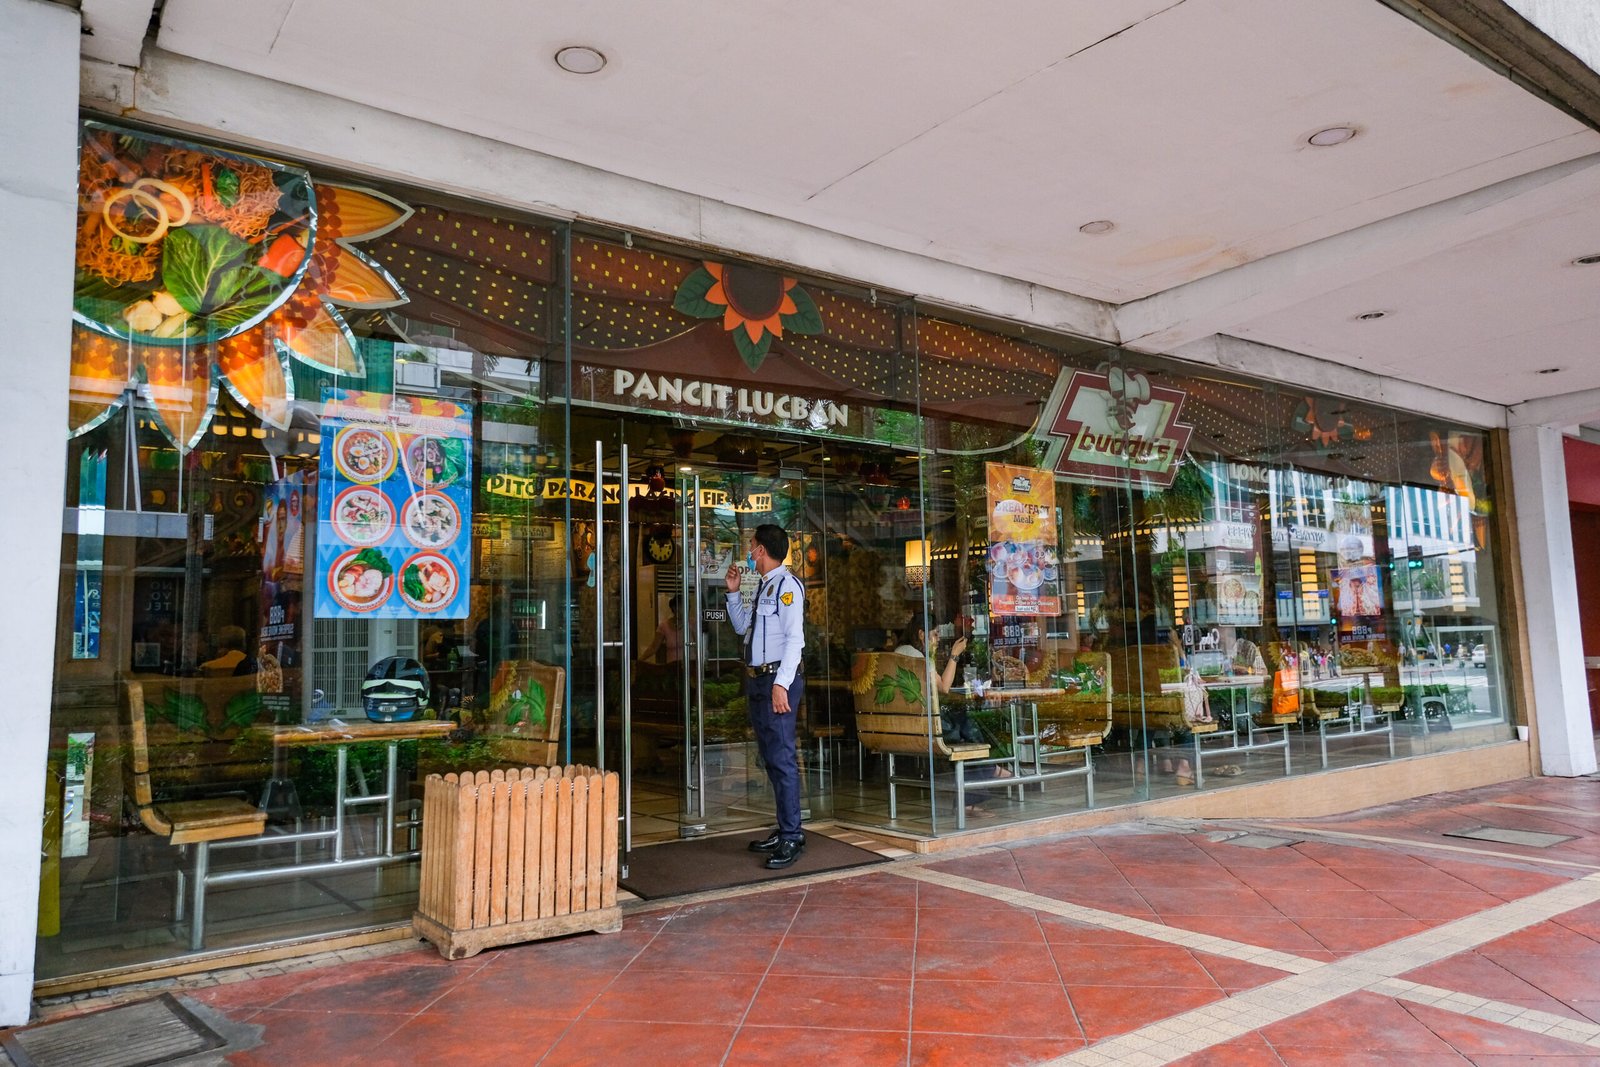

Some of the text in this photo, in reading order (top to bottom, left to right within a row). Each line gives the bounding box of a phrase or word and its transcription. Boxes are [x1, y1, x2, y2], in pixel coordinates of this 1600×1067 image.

[613, 369, 849, 430] PANCIT LUCBAN
[994, 500, 1051, 516] BREAKFAST
[1013, 514, 1035, 524] Meals
[706, 611, 724, 620] PUSH
